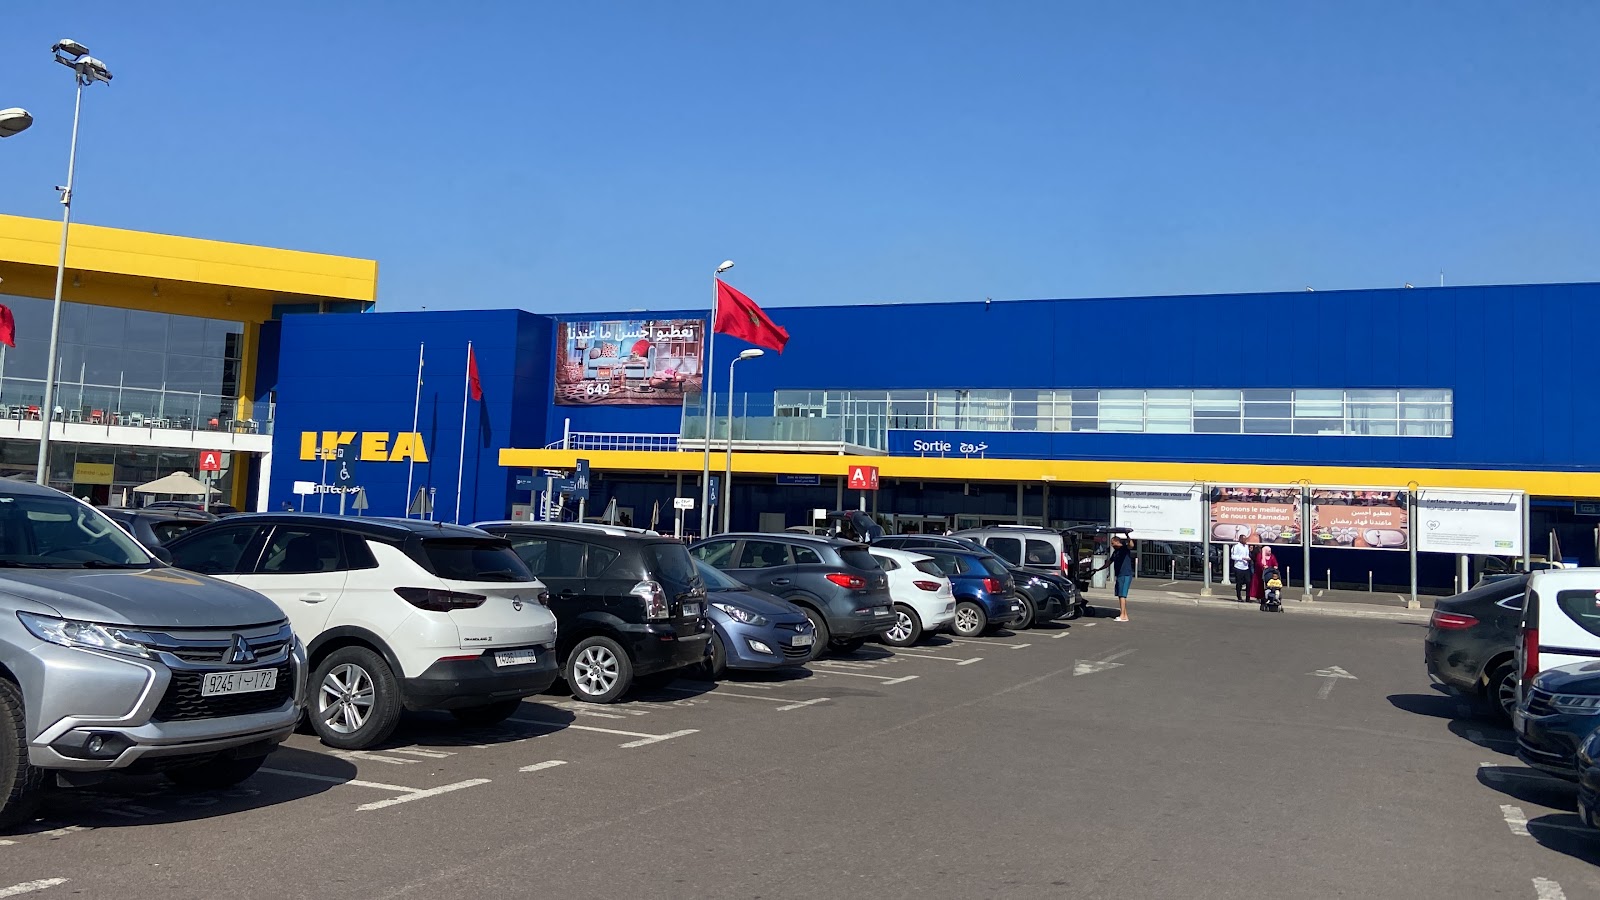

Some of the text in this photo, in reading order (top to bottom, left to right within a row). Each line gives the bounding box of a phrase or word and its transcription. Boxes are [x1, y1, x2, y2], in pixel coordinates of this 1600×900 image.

[587, 383, 610, 395] 649
[300, 431, 429, 462] IKEA
[913, 440, 952, 452] Sortie
[960, 442, 989, 454] خروج
[205, 454, 215, 465] A
[853, 468, 864, 480] A
[871, 469, 877, 481] A
[1220, 505, 1250, 513] Donnons
[1259, 506, 1288, 514] meilleur
[1257, 513, 1290, 521] Ramadan
[209, 675, 234, 692] 9245
[260, 671, 272, 687] 72
